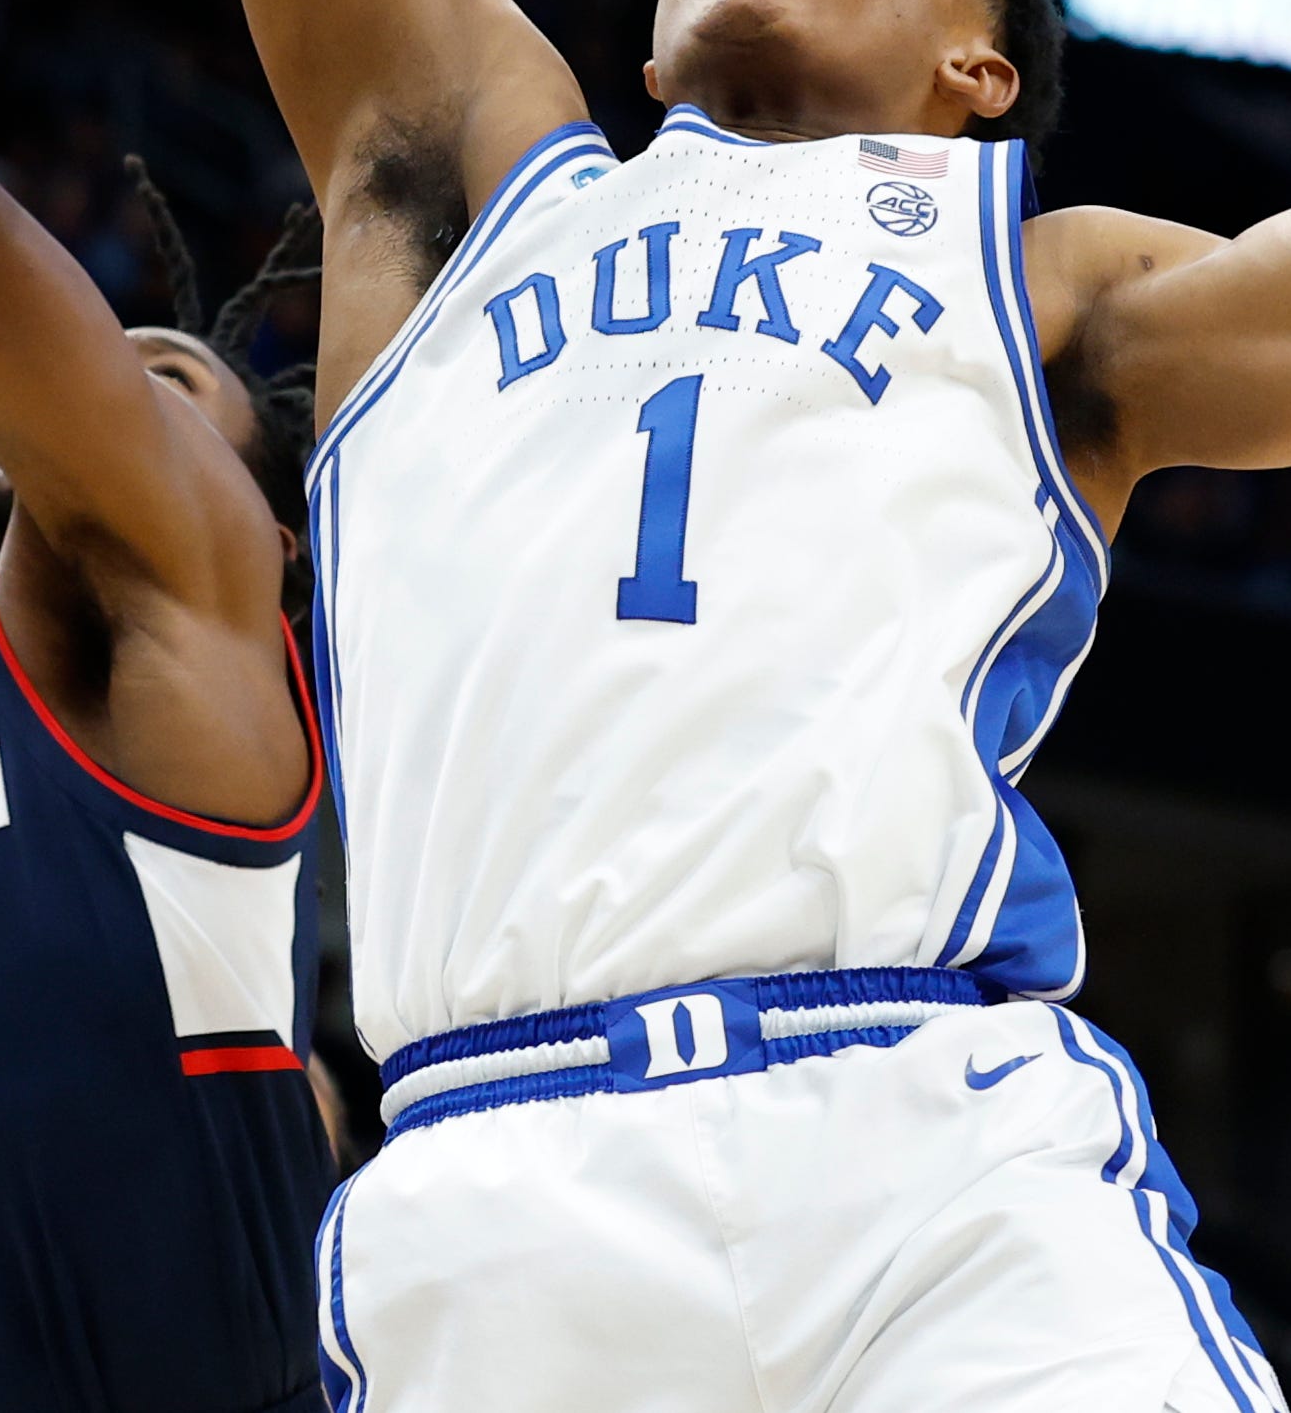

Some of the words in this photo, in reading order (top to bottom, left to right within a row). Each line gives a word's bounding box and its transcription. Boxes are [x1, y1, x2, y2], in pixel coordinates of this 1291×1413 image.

[876, 196, 935, 219] ACC
[483, 221, 945, 406] DUKE
[616, 373, 705, 625] 1
[635, 994, 728, 1078] D
